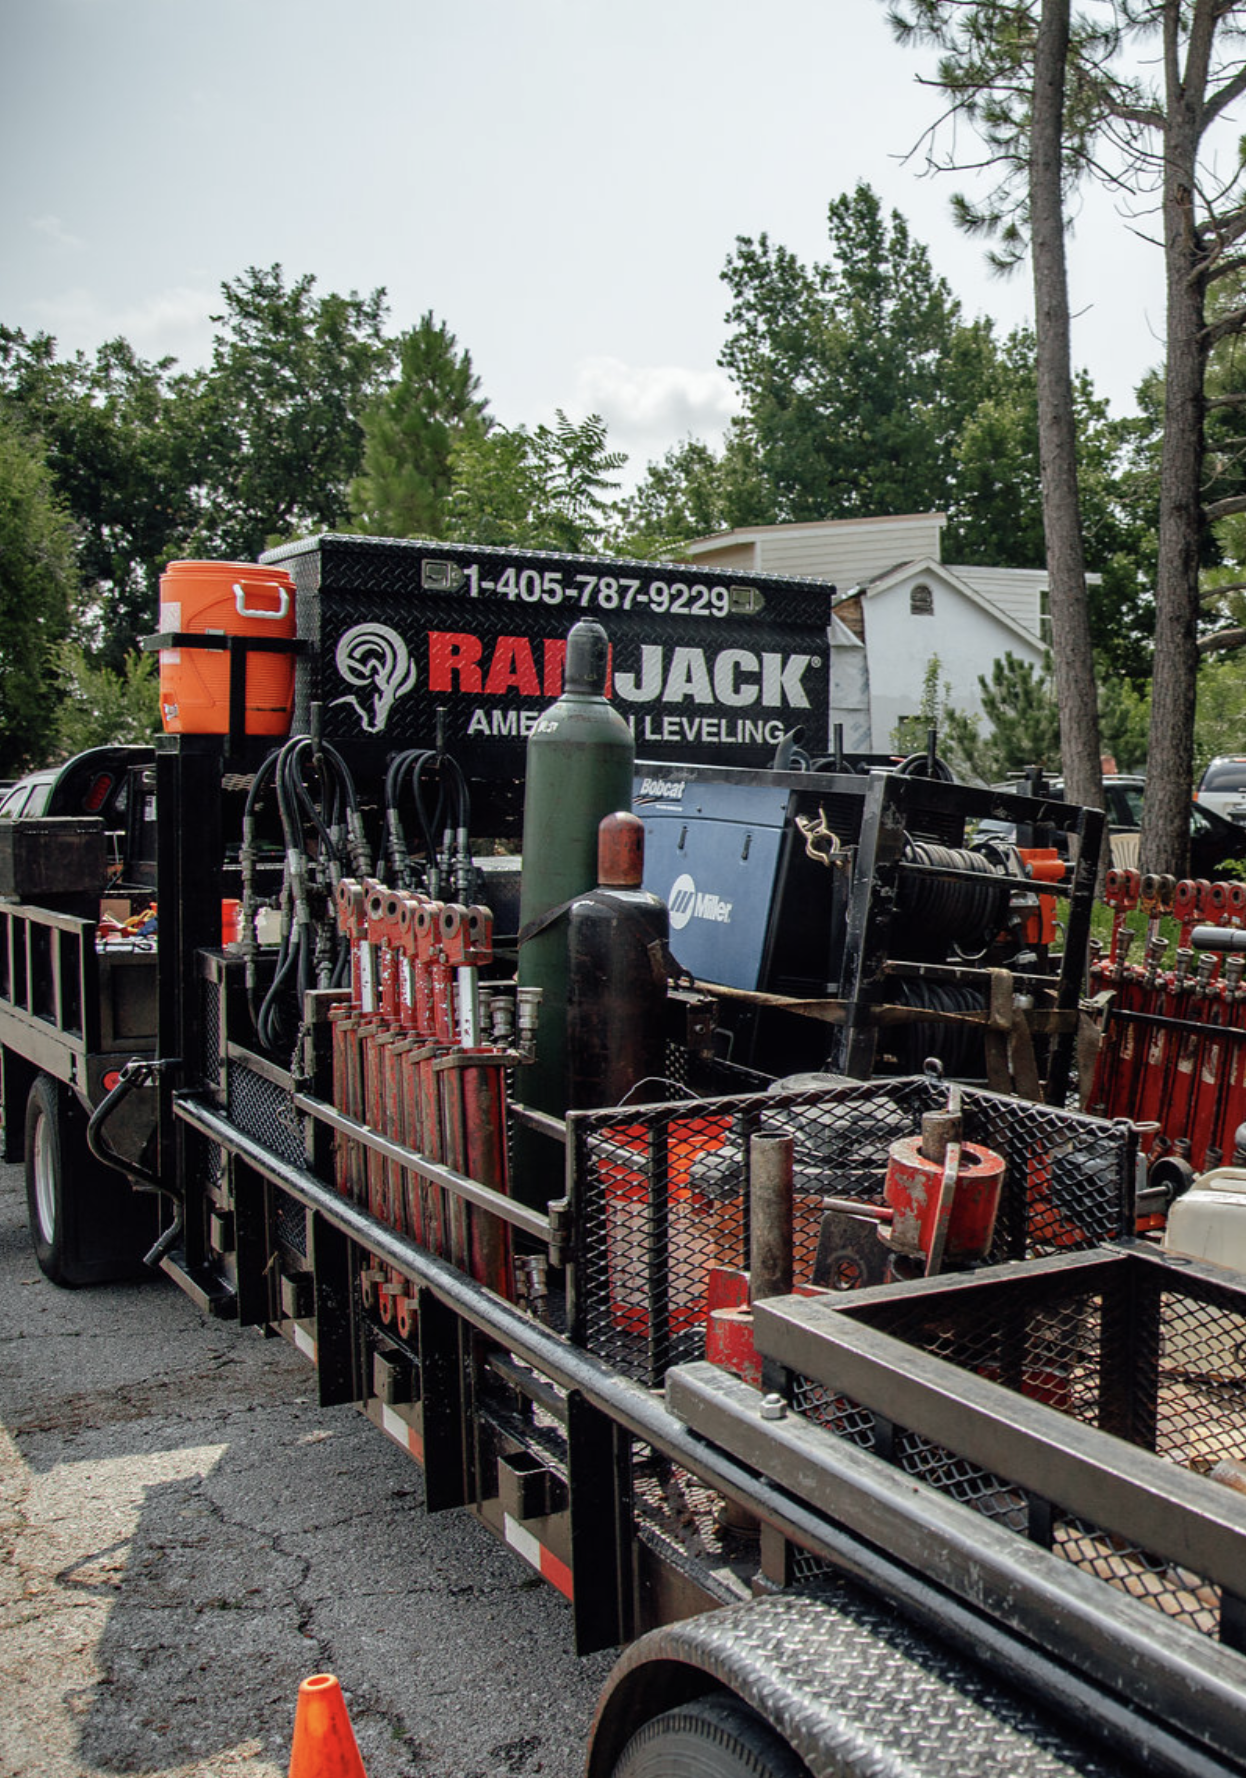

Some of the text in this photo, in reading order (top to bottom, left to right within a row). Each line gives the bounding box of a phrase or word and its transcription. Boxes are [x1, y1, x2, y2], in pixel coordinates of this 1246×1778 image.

[463, 563, 730, 618] 1-405-787-9229
[644, 715, 785, 745] LEVELING
[640, 778, 686, 799] Bobcat
[693, 892, 733, 924] Miller
